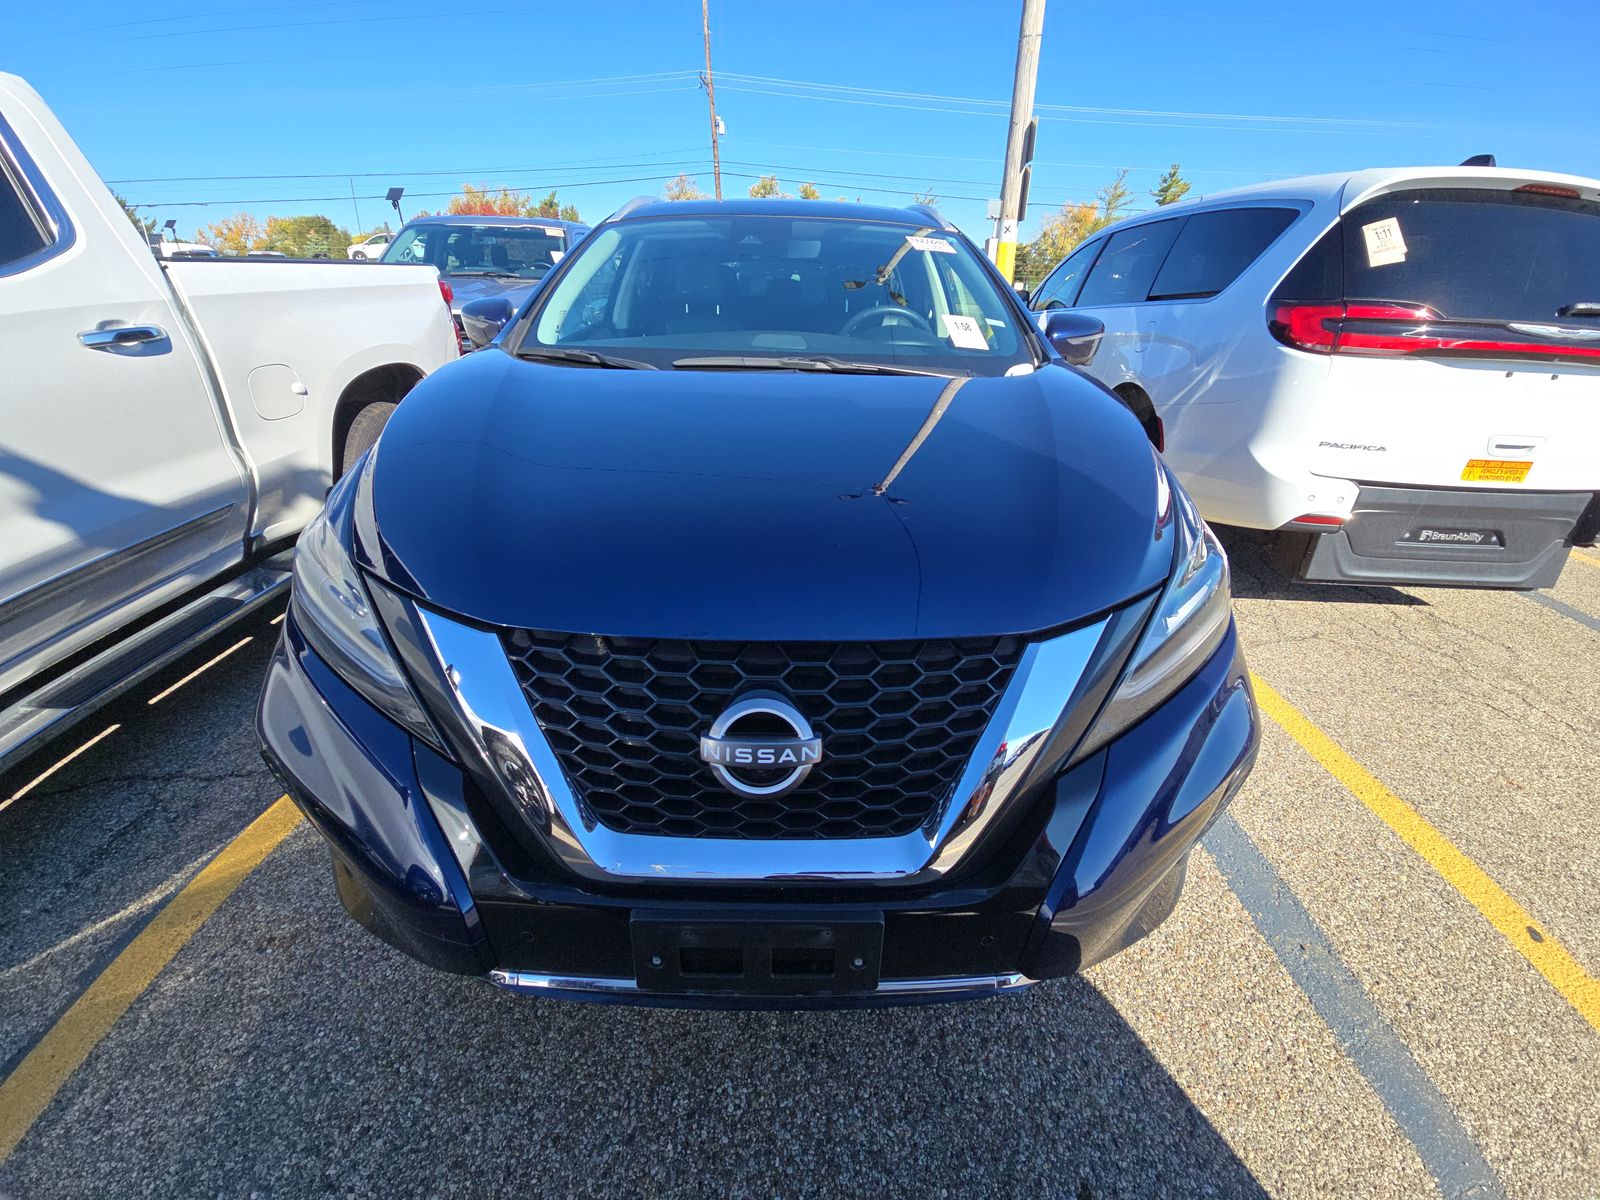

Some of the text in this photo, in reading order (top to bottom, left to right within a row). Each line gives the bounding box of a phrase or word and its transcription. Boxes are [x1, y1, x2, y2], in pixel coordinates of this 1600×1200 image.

[1318, 441, 1387, 451] PACIFICA
[1431, 531, 1484, 543] BraunAbility
[703, 744, 820, 764] NISSAN
